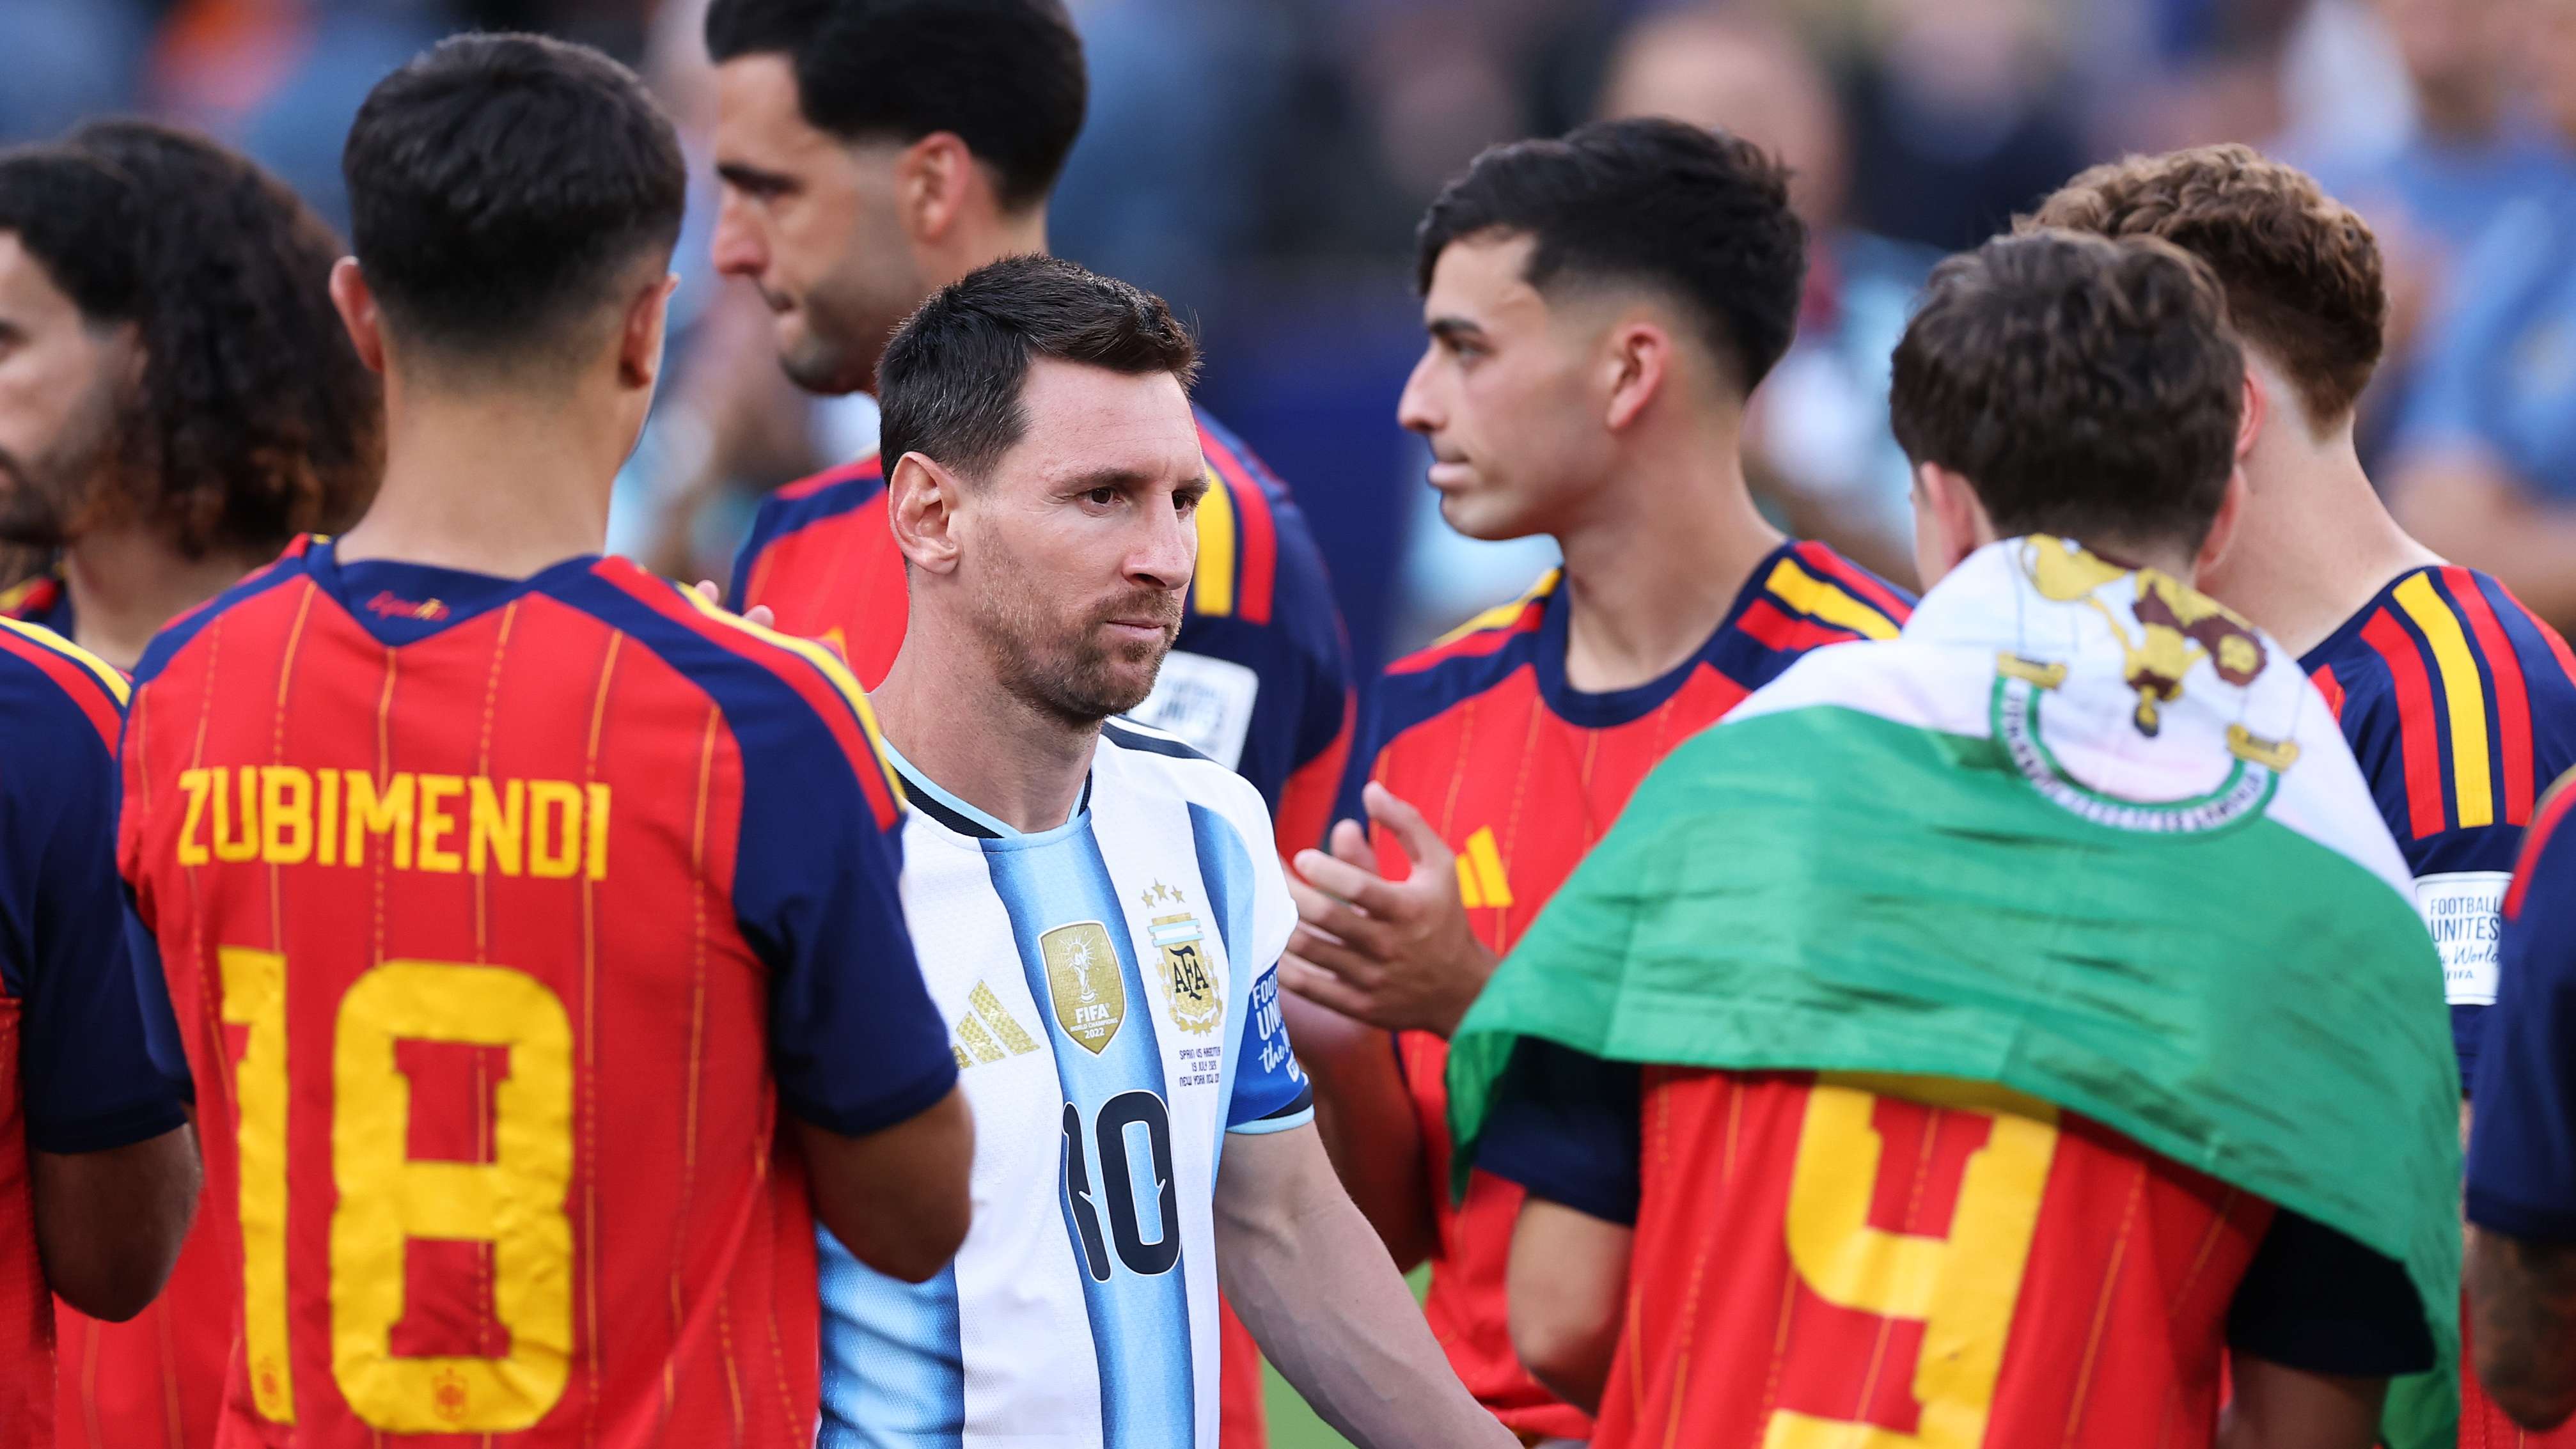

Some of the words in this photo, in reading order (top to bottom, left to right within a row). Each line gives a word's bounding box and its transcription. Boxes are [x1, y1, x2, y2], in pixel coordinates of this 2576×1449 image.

[178, 765, 611, 881] ZUBIMENDI
[2431, 896, 2500, 915] FOOTBALL
[2431, 917, 2500, 943] UNITES
[1168, 945, 1209, 1000] AFA
[2446, 970, 2473, 980] FIFA
[1075, 1003, 1110, 1024] FIFA
[1084, 1027, 1105, 1039] 2022
[217, 945, 573, 1434] 18
[1062, 1090, 1181, 1283] 10
